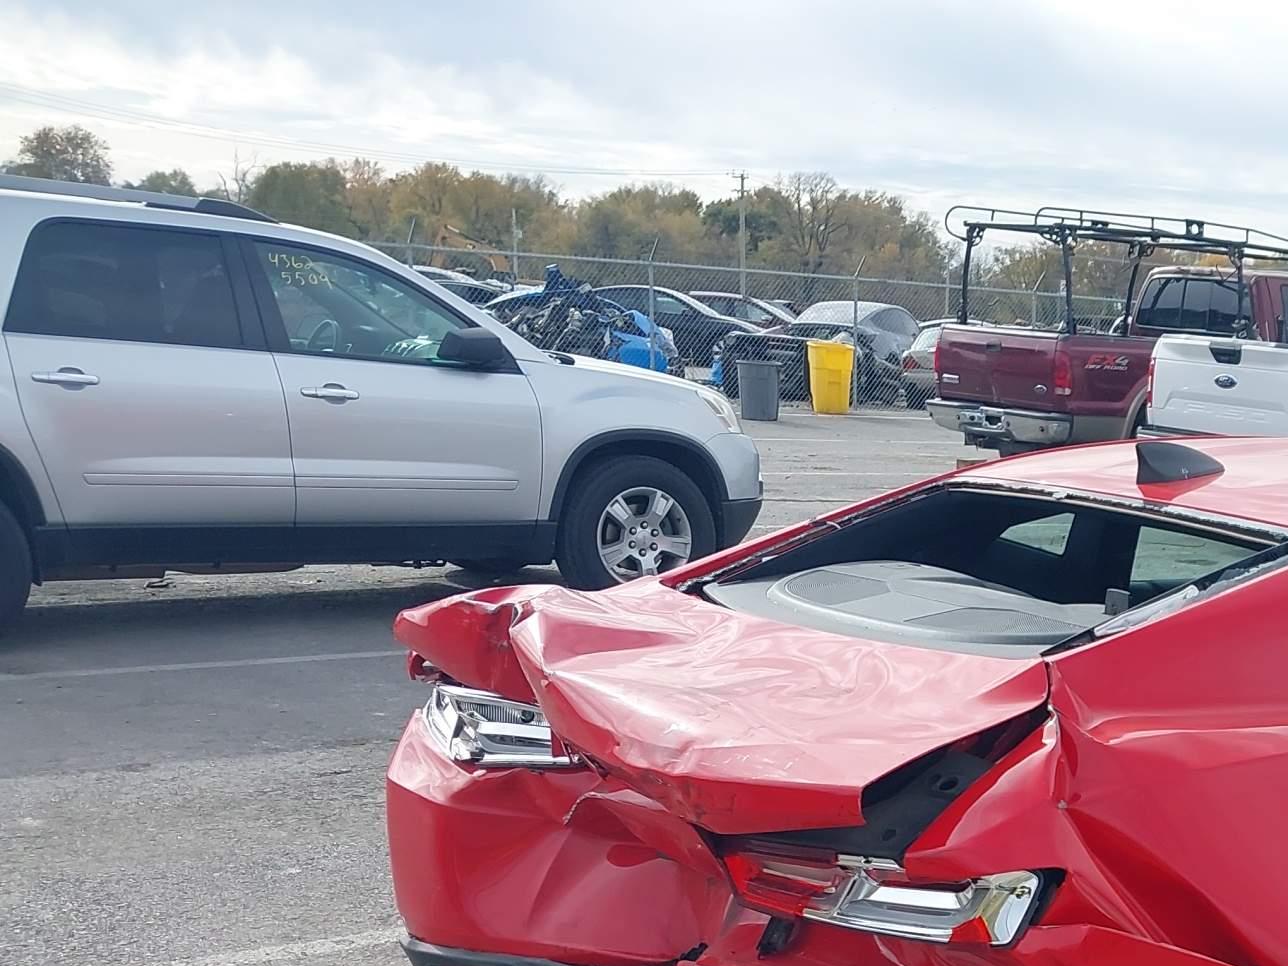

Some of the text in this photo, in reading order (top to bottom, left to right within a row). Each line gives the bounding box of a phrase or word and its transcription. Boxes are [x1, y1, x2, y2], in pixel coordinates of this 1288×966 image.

[268, 252, 313, 270] 4362
[281, 271, 333, 289] 5509
[1087, 353, 1129, 366] FX4
